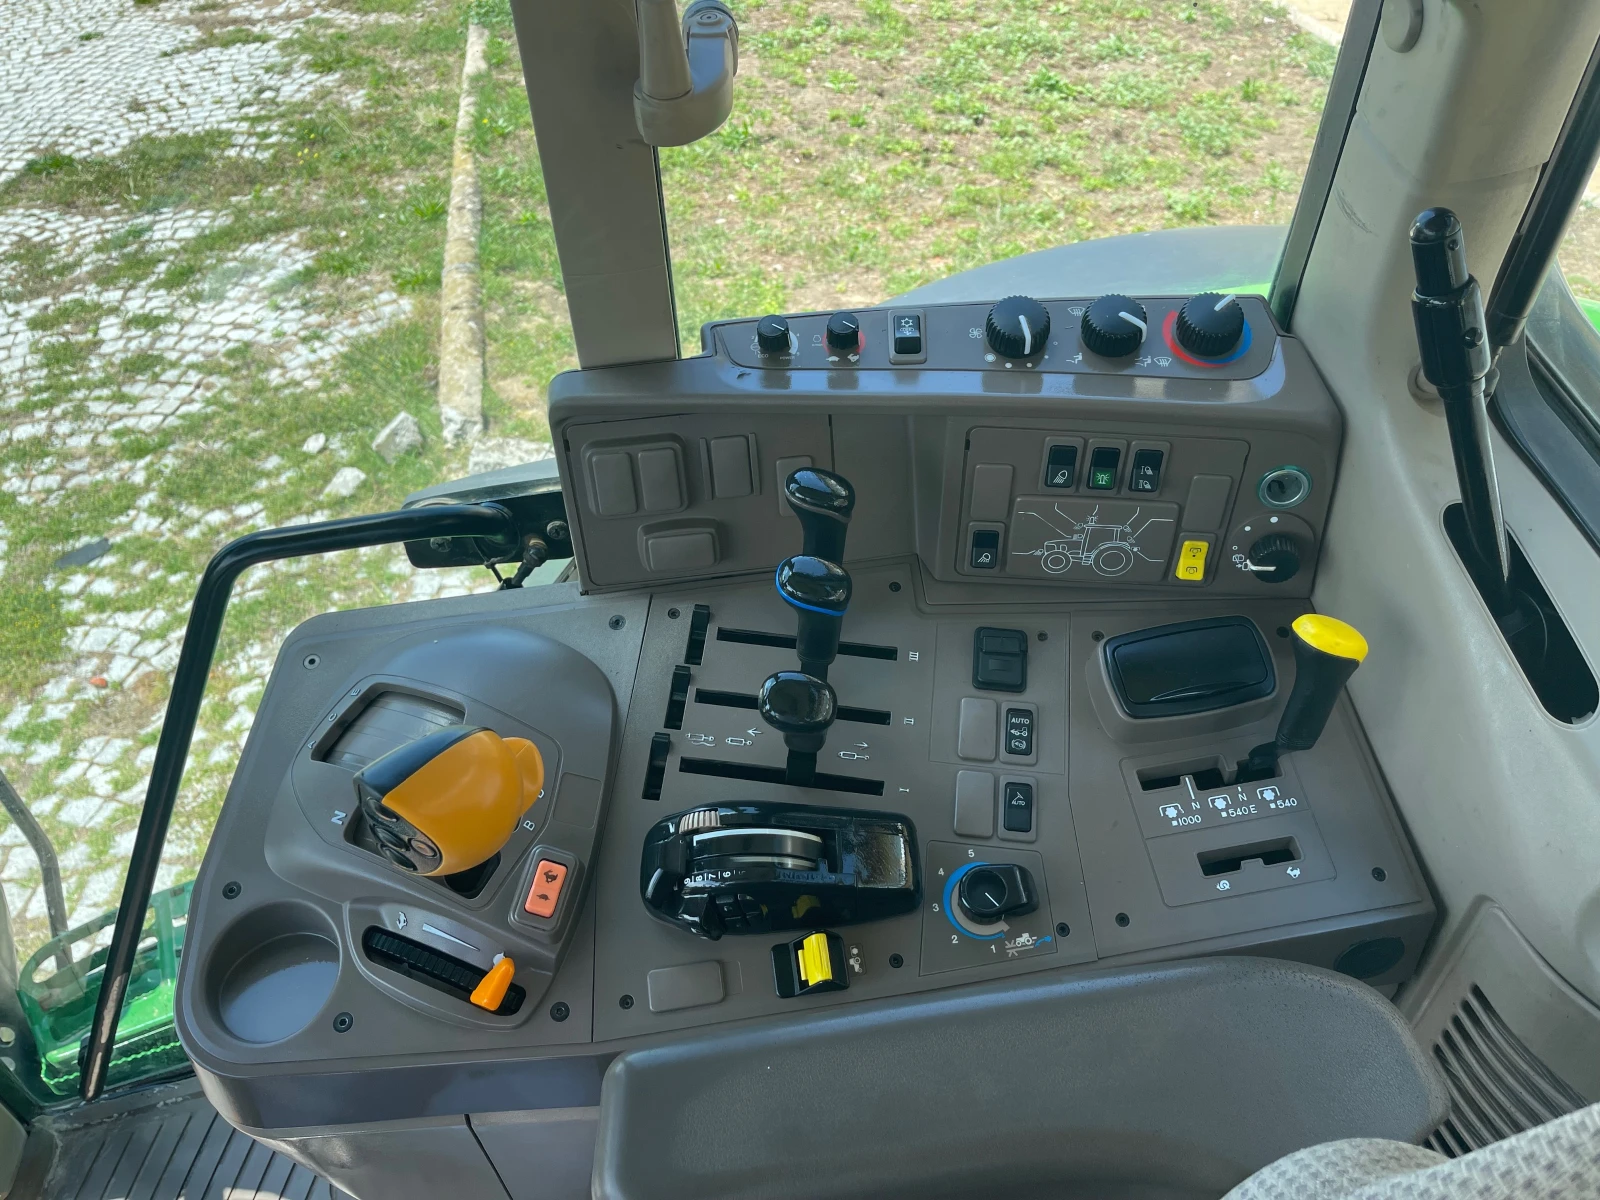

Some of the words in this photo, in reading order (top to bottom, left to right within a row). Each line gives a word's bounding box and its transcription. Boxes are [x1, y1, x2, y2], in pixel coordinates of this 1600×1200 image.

[909, 651, 919, 662] III
[350, 688, 361, 697] E
[328, 712, 338, 722] C
[904, 717, 914, 725] II
[1010, 717, 1030, 725] AUTO
[307, 740, 316, 749] A
[1238, 793, 1248, 802] N
[1191, 801, 1201, 811] N
[1276, 797, 1298, 809] 540
[1228, 805, 1249, 818] 540
[1249, 804, 1258, 814] E
[330, 810, 347, 825] N
[1178, 814, 1202, 826] 1000
[523, 820, 536, 831] B
[968, 849, 975, 858] 5
[938, 867, 945, 876] 4
[695, 874, 703, 882] 8
[932, 903, 939, 912] 3
[951, 935, 959, 944] 2
[990, 944, 996, 953] 1
